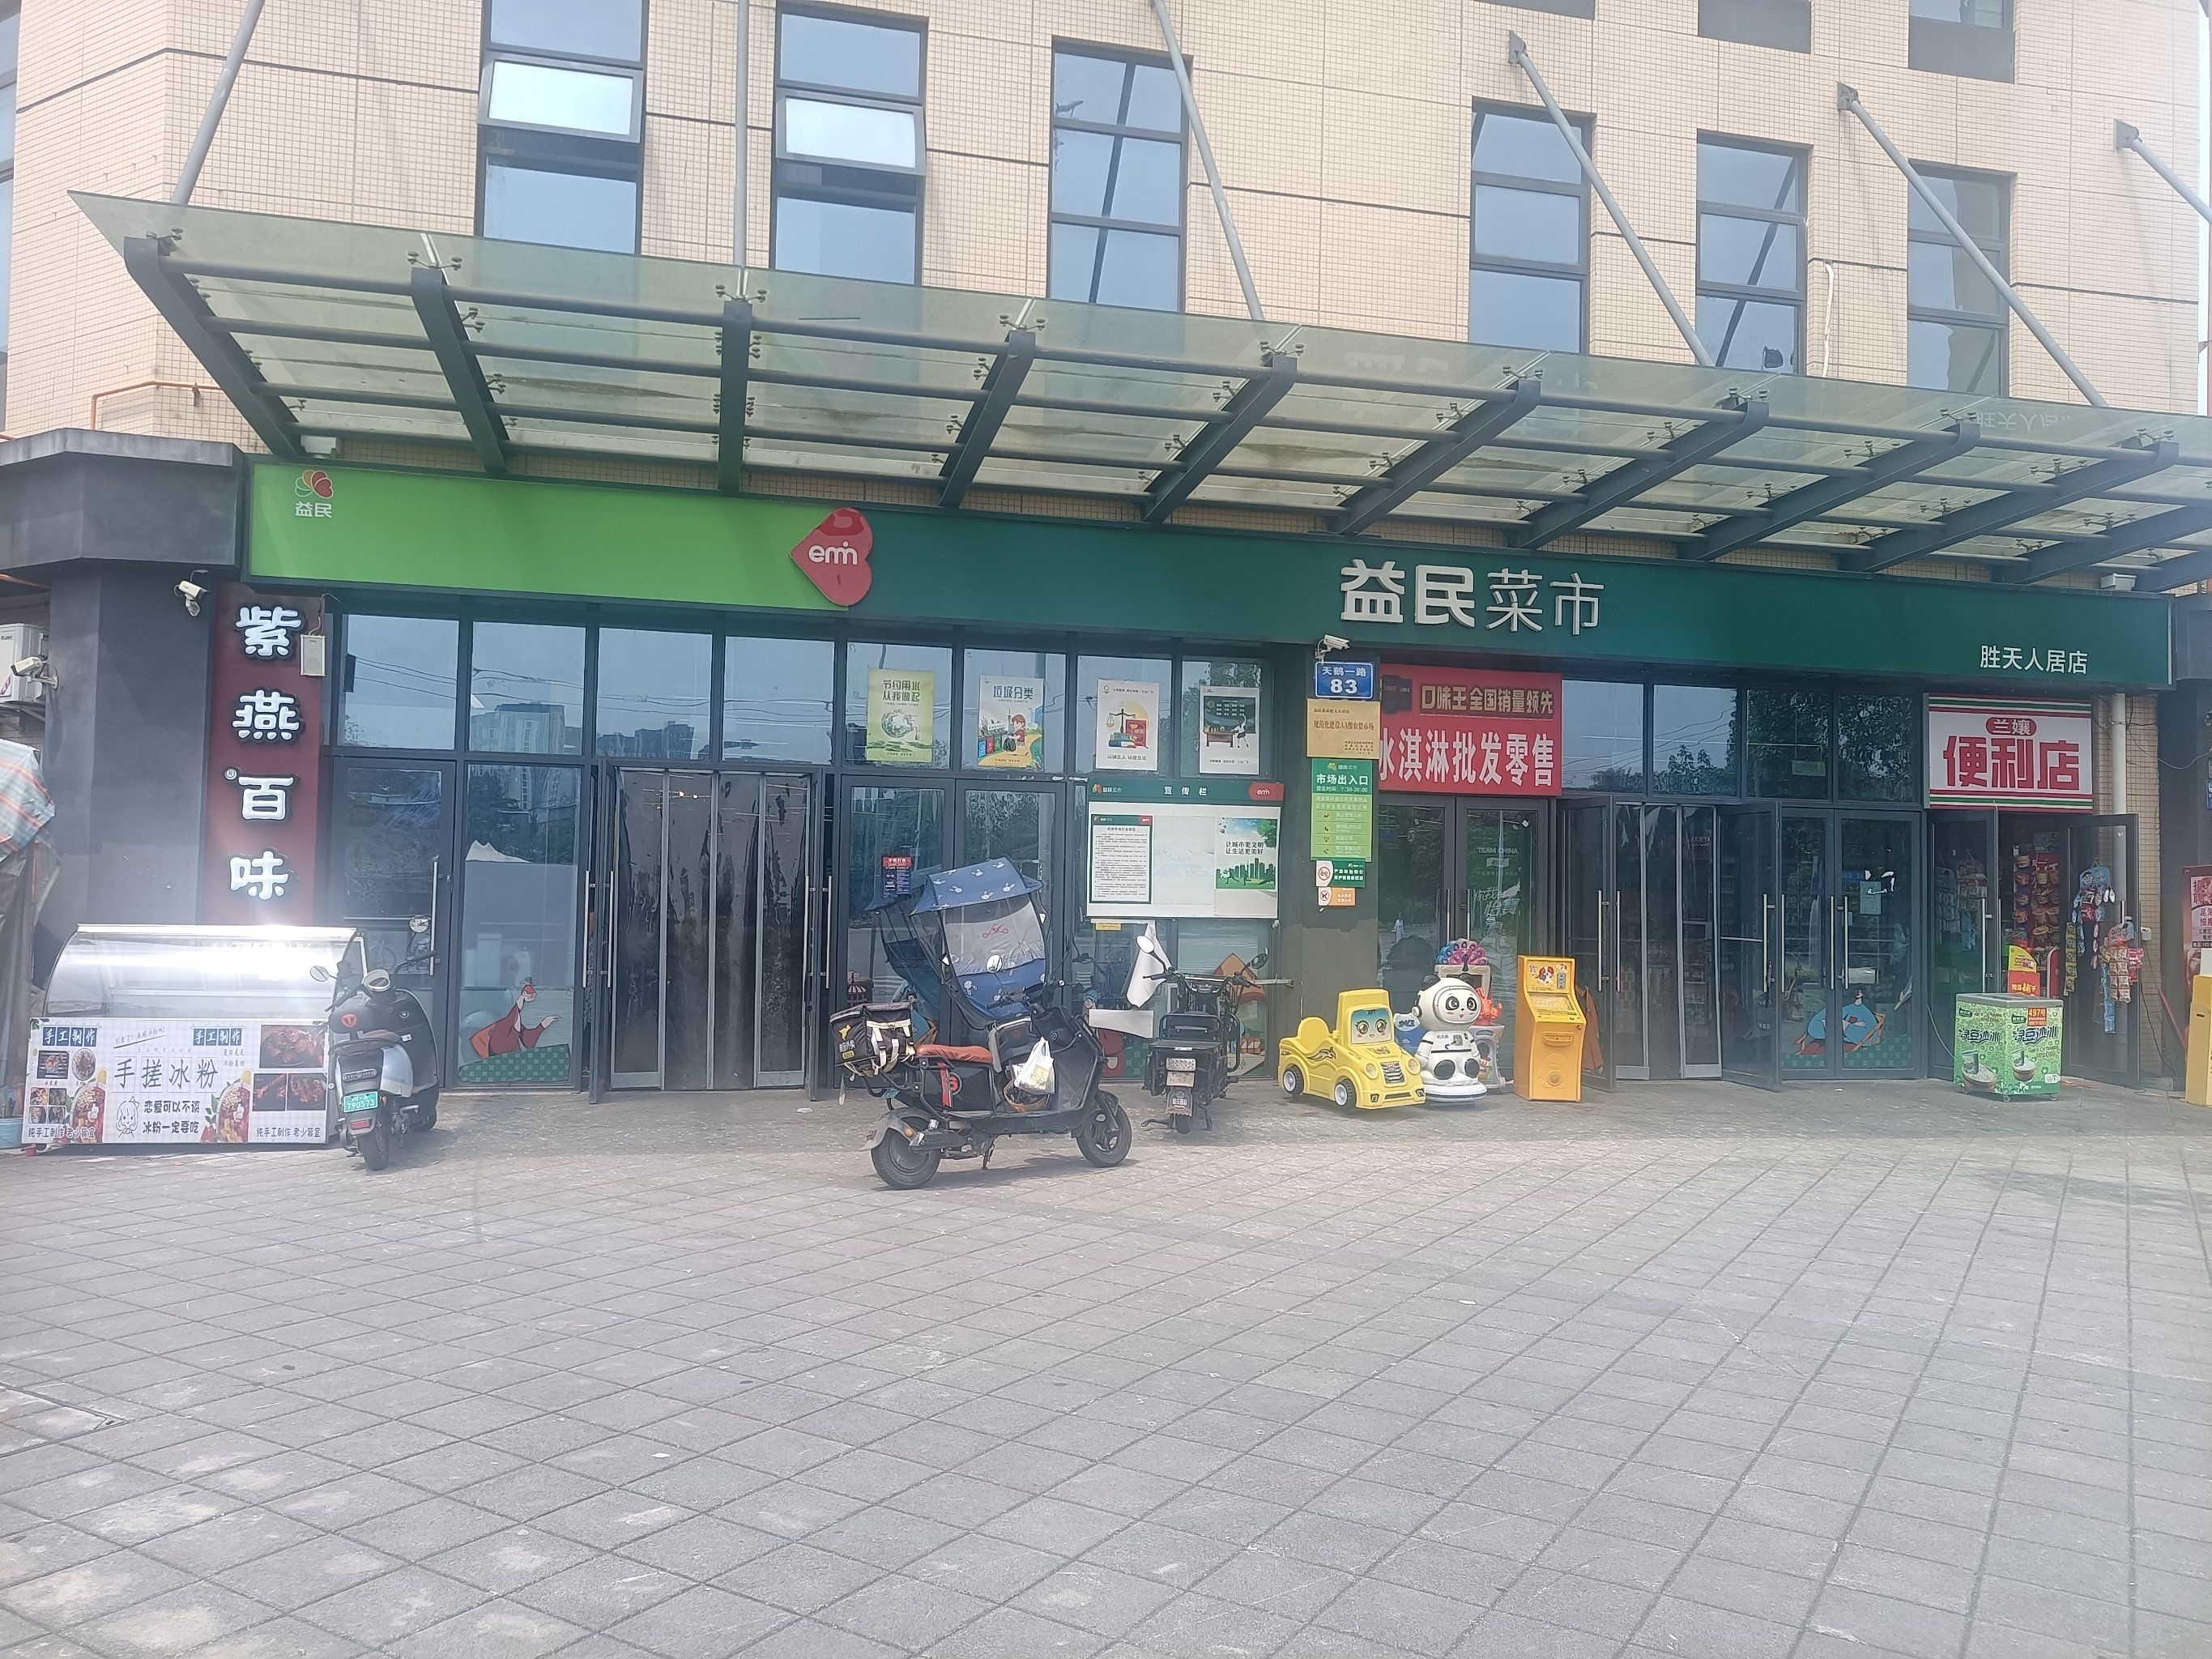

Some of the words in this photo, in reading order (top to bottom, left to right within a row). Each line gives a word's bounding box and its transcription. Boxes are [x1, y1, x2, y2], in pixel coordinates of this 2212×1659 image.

[295, 501, 332, 518] 益民
[1340, 559, 1605, 636] 益民菜市
[1980, 645, 2088, 675] 胜天人居店
[1322, 666, 1366, 677] 天鹅一路
[882, 680, 920, 691] 节约用水
[993, 684, 1034, 700] 垃圾分类
[1330, 679, 1357, 694] 83
[882, 690, 920, 702] 从我做起
[1421, 685, 1467, 710] 口味王
[1469, 687, 1554, 714] 全国销量领先
[231, 606, 302, 901] 紫燕百味
[1943, 736, 2080, 791] 便利店
[1316, 774, 1369, 786] 市场出入口
[1477, 847, 1497, 855] TEAM
[1498, 847, 1519, 855] CHINA
[44, 1028, 96, 1047] 手工制作
[194, 1029, 242, 1045] 手工制作
[114, 1058, 219, 1090] 手搓冰粉
[143, 1100, 200, 1114] 恋爱可以不谈
[347, 1098, 375, 1110] 790573
[28, 1127, 65, 1139] 纯手工制作
[66, 1126, 96, 1139] 老少皆宜
[143, 1120, 199, 1134] 冰粉一定要吃
[257, 1127, 292, 1138] 纯手工制作
[292, 1127, 321, 1138] 老少皆宜
